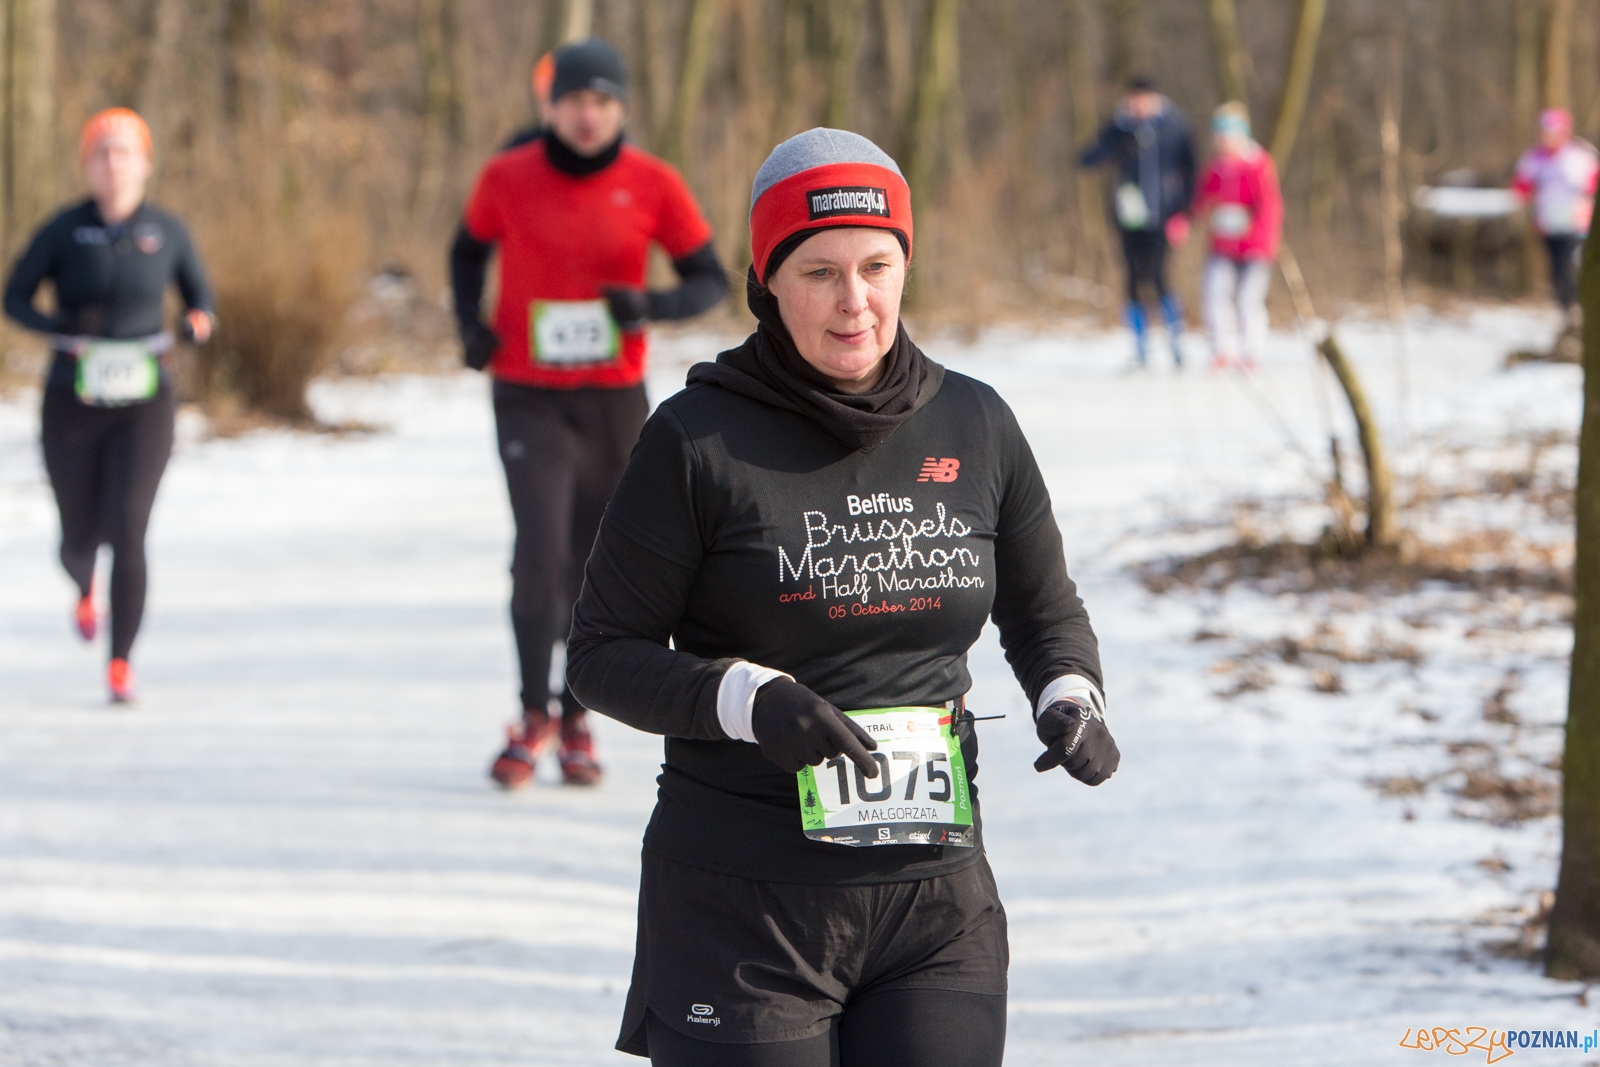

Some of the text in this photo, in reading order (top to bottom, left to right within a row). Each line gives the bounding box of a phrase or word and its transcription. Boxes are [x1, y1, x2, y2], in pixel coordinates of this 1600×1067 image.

[916, 457, 960, 483] NB
[846, 493, 914, 516] Belfius
[803, 502, 971, 548] Brussels
[778, 541, 979, 582] Marathon
[779, 567, 985, 603] and Half Marathon
[828, 597, 941, 618] 05 October 2014
[826, 751, 951, 805] 1075
[955, 766, 967, 810] Poznań
[858, 807, 939, 822] MAŁGORZATA
[687, 1014, 721, 1027] Kalenji
